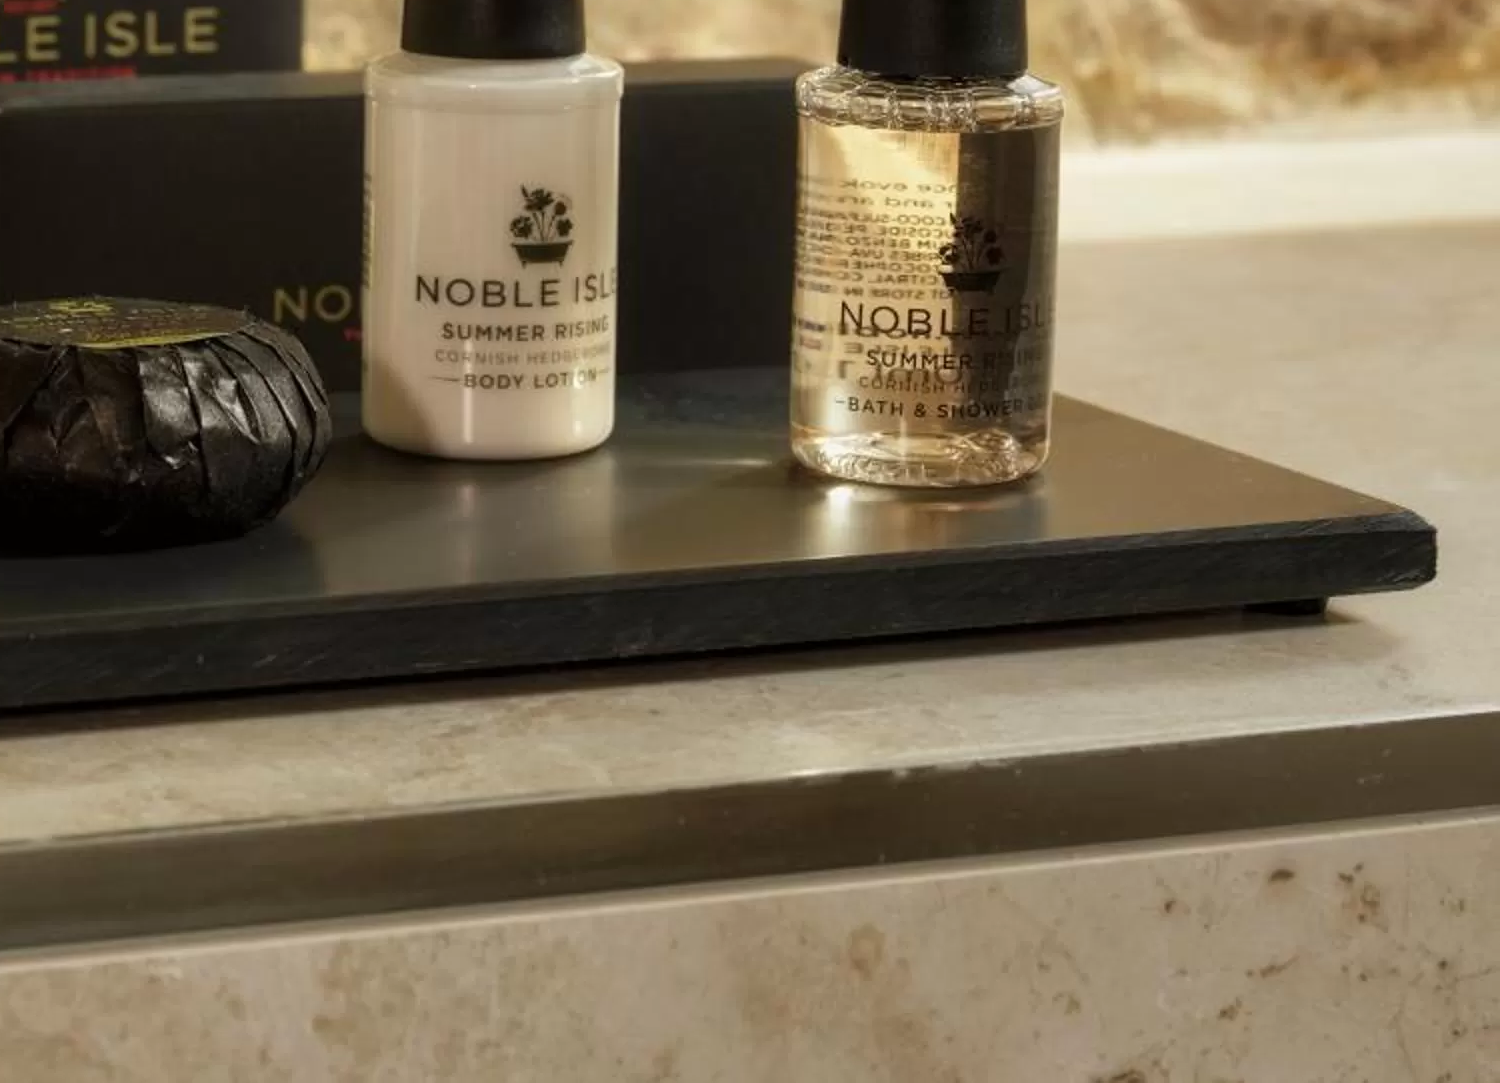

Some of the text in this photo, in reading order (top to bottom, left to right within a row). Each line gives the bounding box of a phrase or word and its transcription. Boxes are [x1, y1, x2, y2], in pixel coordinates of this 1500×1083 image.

[84, 7, 220, 58] ISLE
[415, 274, 561, 309] NOBLE
[441, 314, 610, 342] SUMMER RISING
[839, 299, 989, 337] NOBLE
[866, 350, 973, 371] SUMMER
[463, 367, 598, 390] BODY LOTION
[848, 396, 904, 417] BATH
[914, 403, 927, 418] &
